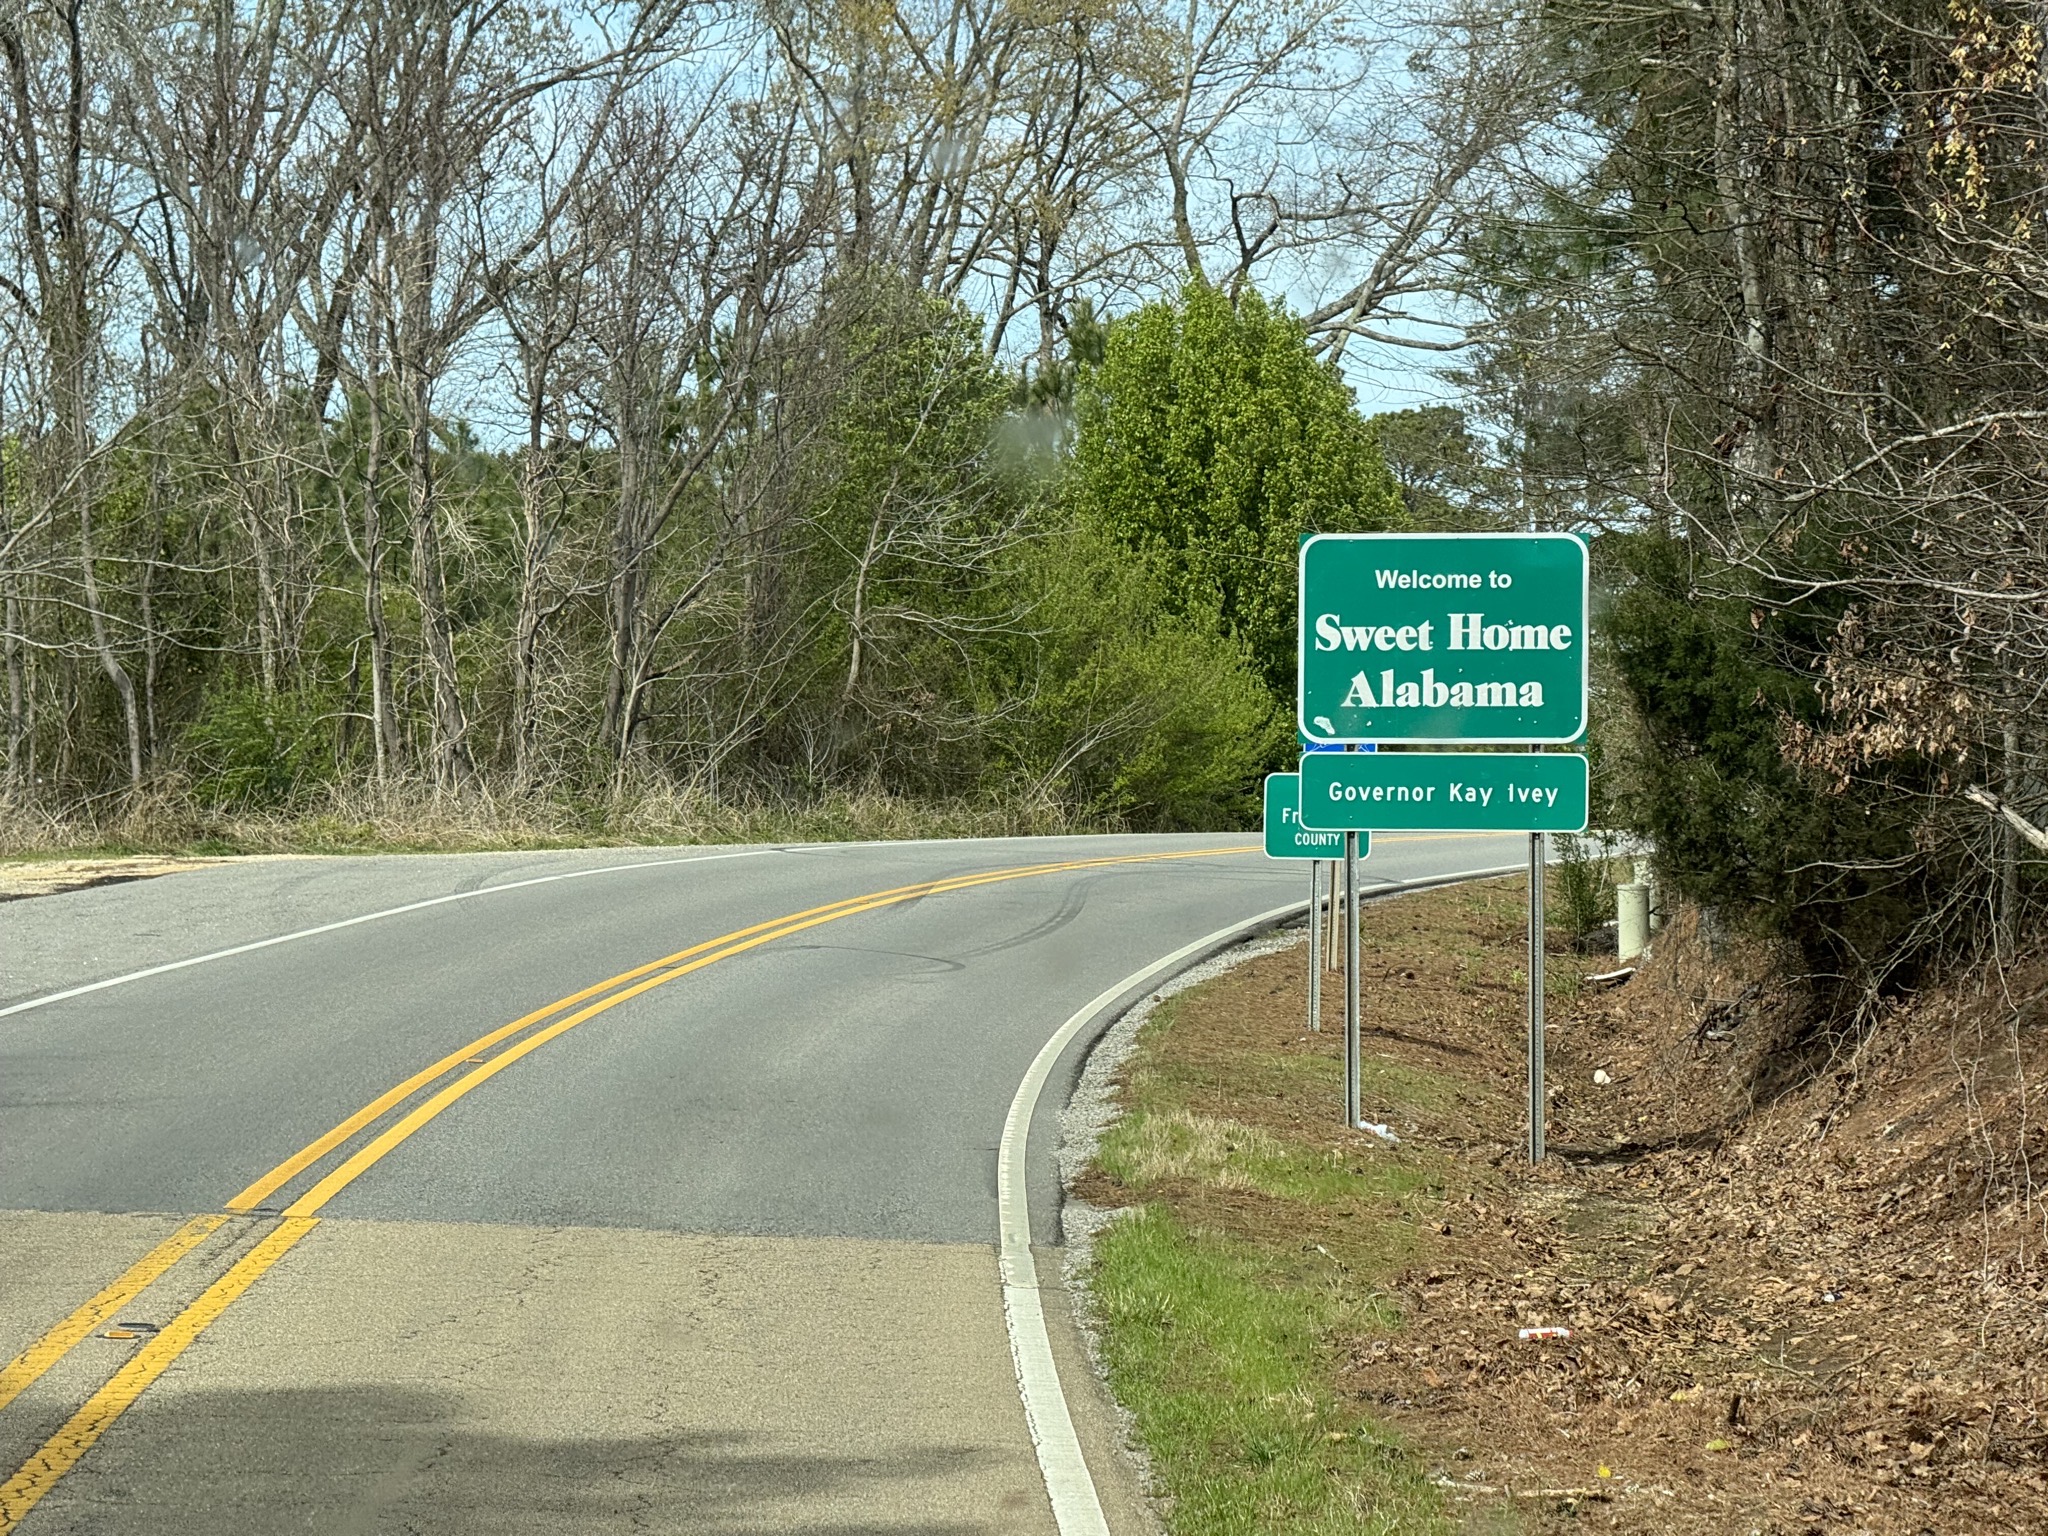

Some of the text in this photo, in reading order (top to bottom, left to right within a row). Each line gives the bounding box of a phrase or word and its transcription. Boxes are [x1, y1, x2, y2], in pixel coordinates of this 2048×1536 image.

[1374, 569, 1512, 589] Welcome to
[1315, 613, 1572, 652] Sweet Home
[1340, 667, 1545, 708] Alabama
[1328, 781, 1559, 808] Governor Kay Ivey
[1294, 832, 1341, 846] COUNTY
